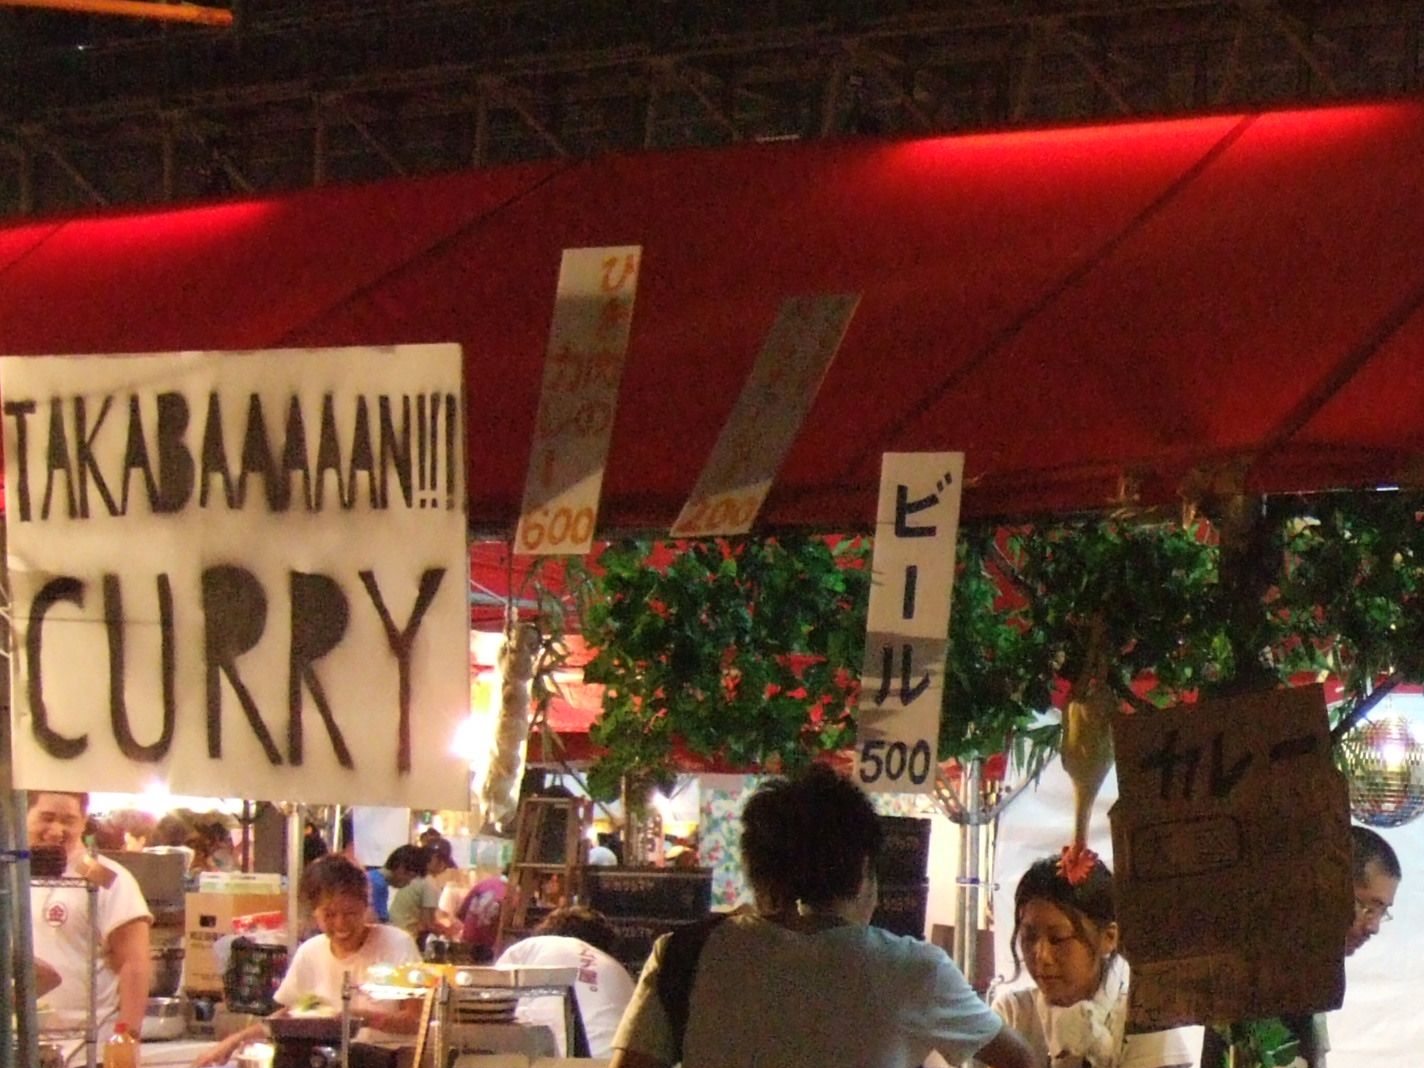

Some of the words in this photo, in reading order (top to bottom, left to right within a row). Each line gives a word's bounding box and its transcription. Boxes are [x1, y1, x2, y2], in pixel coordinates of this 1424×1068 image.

[521, 505, 594, 551] 600
[872, 472, 953, 707] ビール
[25, 564, 448, 778] CURRY
[859, 738, 932, 786] 500
[1142, 729, 1318, 801] カレー
